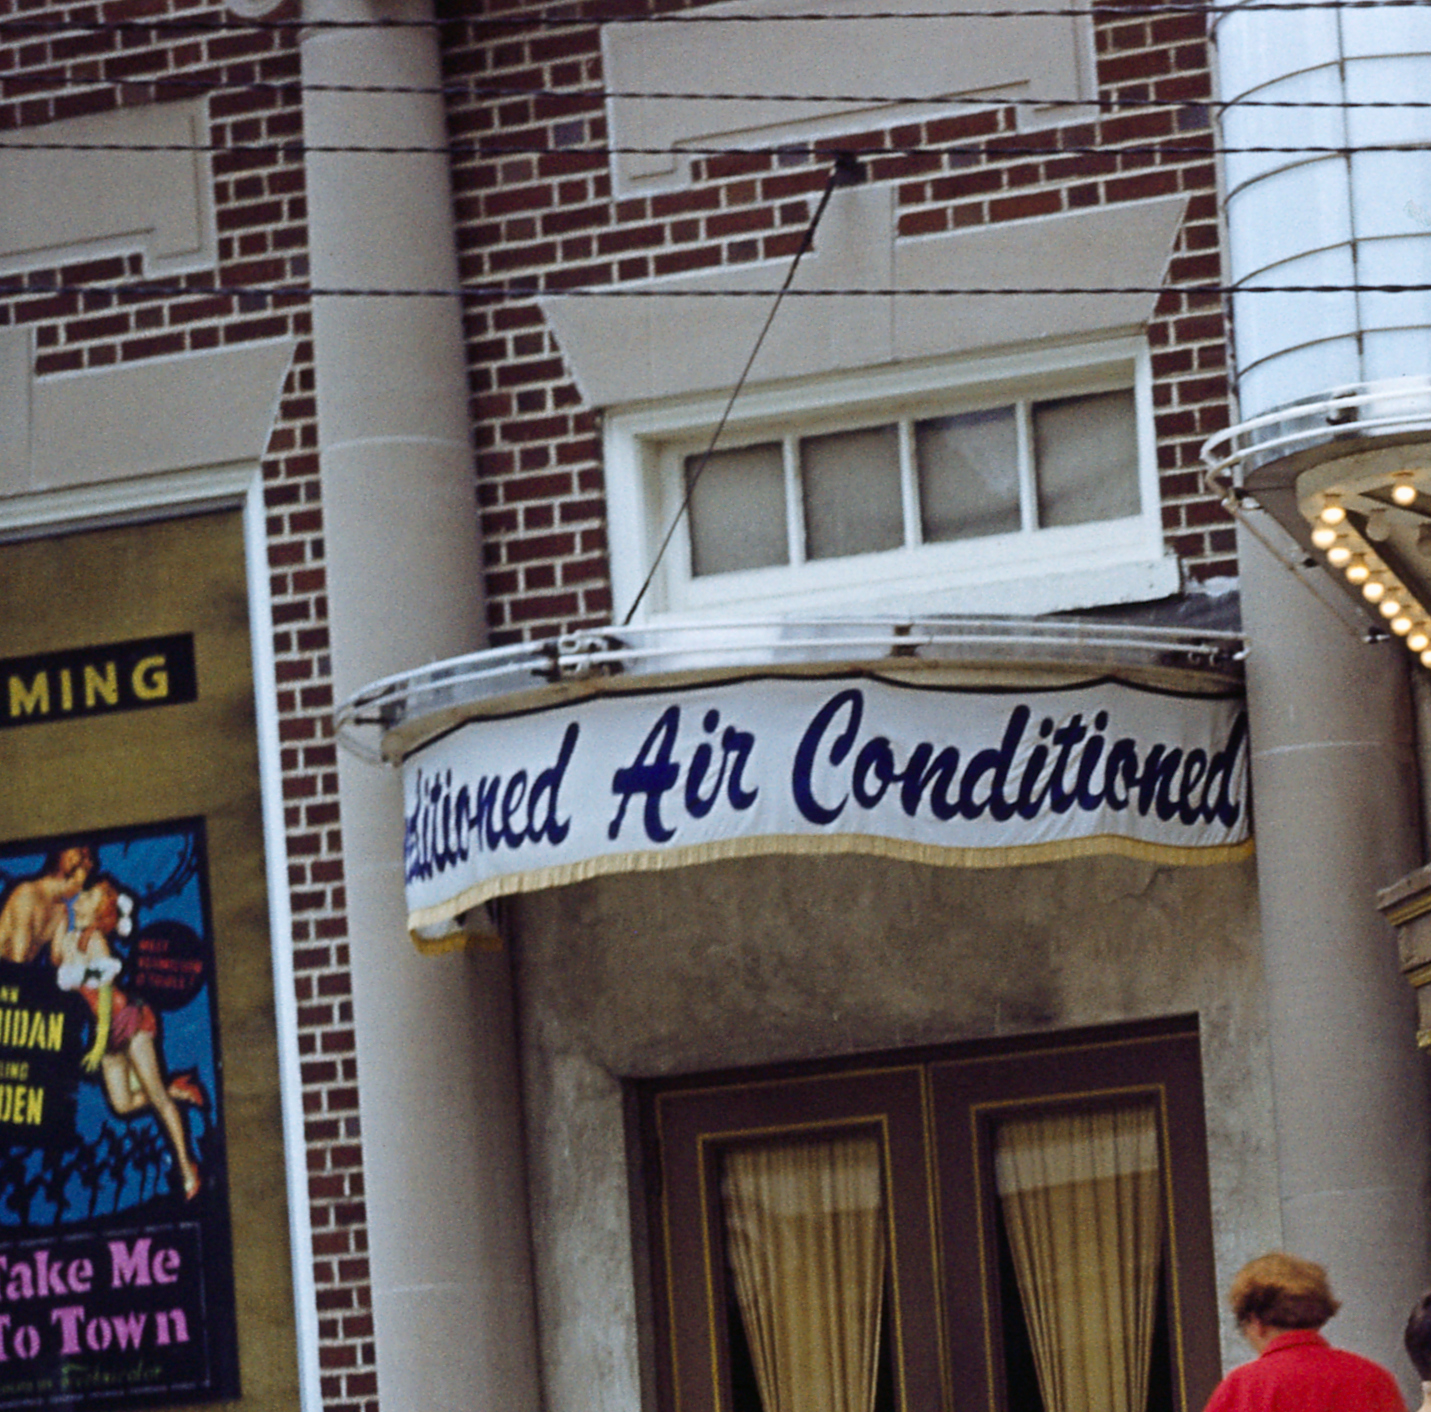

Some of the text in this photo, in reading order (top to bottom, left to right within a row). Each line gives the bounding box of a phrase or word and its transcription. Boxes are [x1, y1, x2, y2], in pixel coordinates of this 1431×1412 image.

[403, 688, 1247, 884] ditioned Air Conditioned
[0, 1006, 65, 1052] IDAN
[0, 1237, 182, 1300] ake Me
[51, 1305, 190, 1357] Town
